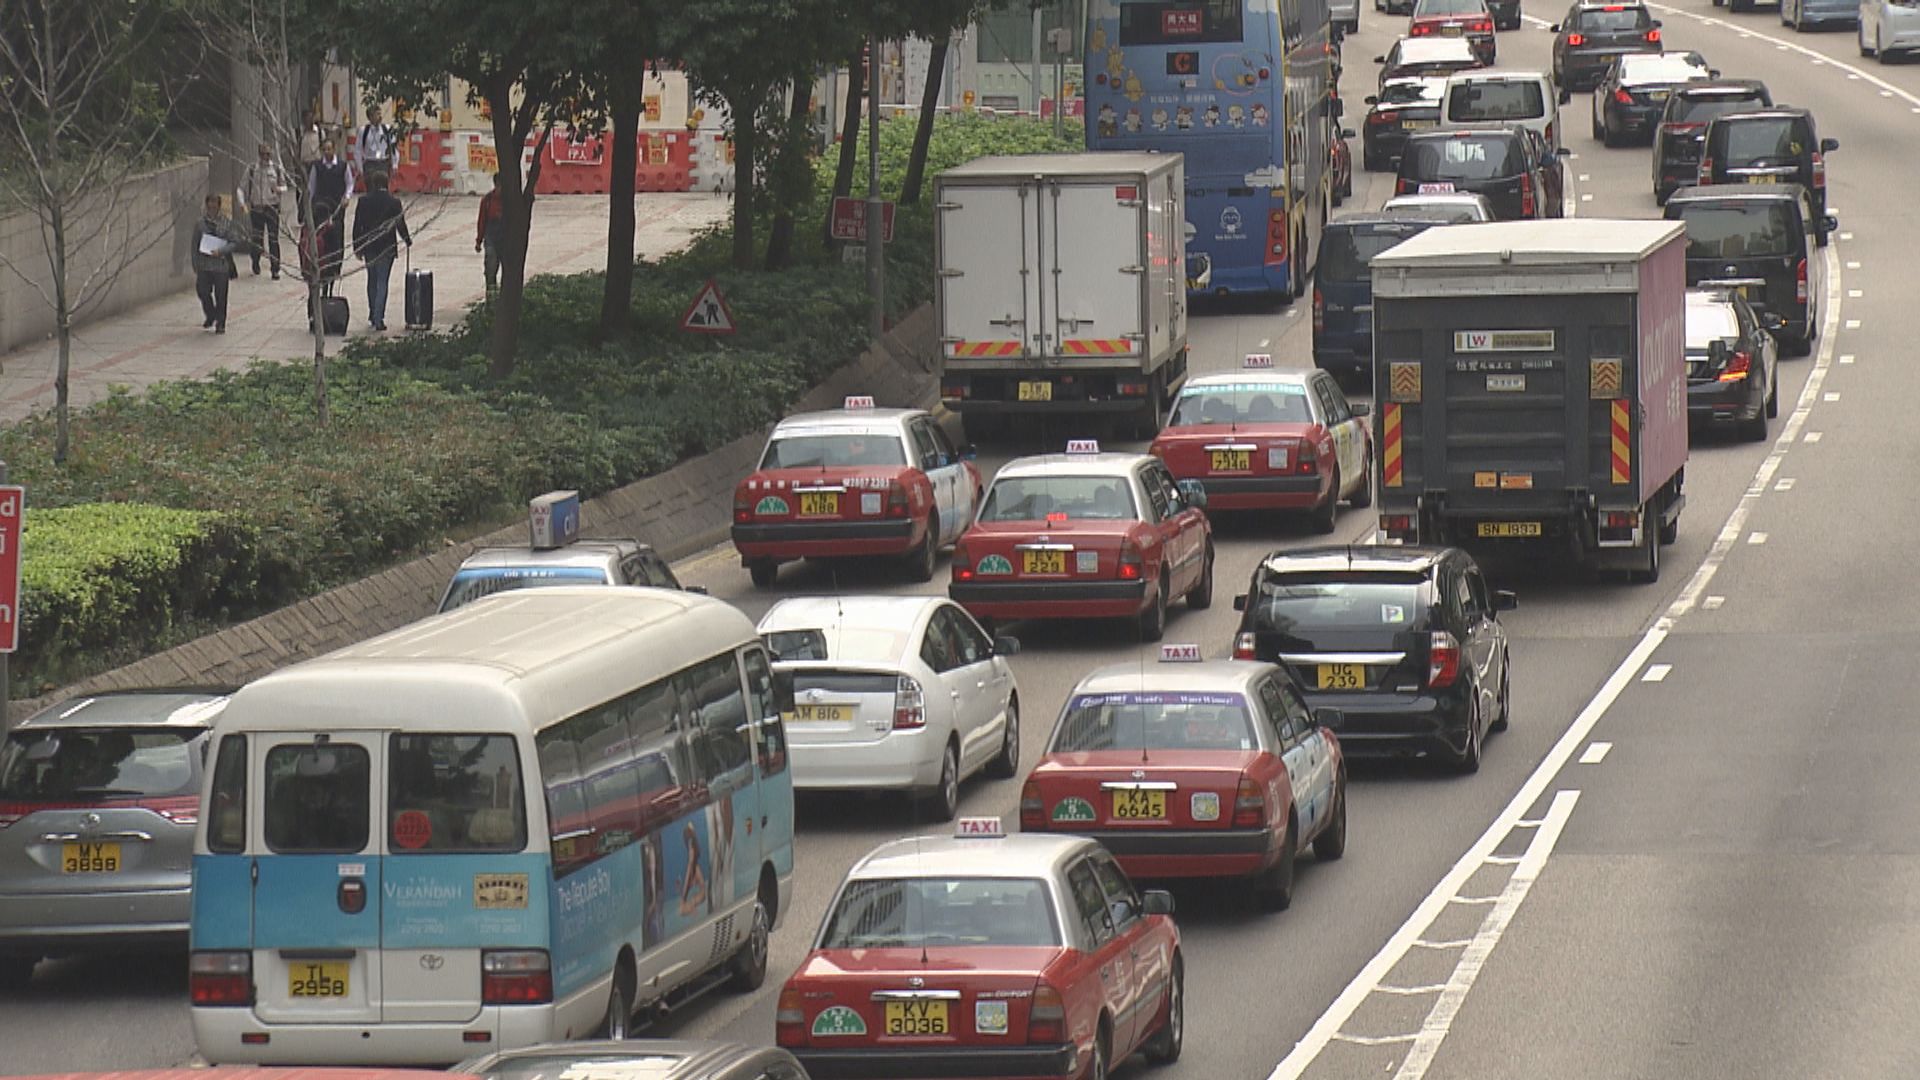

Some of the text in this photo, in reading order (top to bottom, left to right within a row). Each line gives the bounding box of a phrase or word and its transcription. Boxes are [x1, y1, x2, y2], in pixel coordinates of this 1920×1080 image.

[1246, 354, 1271, 364] TAXI
[1070, 442, 1096, 450] TAXI
[1030, 562, 1060, 573] 229
[1163, 647, 1196, 658] TAXI
[1331, 664, 1352, 676] UG
[1326, 676, 1358, 688] 239
[791, 706, 840, 720] AM 816
[1127, 790, 1150, 804] KA
[1117, 804, 1161, 817] 6645
[959, 820, 998, 833] TAXI
[80, 842, 104, 858] MY
[66, 858, 116, 872] 3898
[383, 881, 462, 898] VERANDAH
[306, 965, 331, 983] TL
[293, 980, 345, 996] 2958
[903, 1001, 930, 1018] KV
[890, 1018, 945, 1034] 3036
